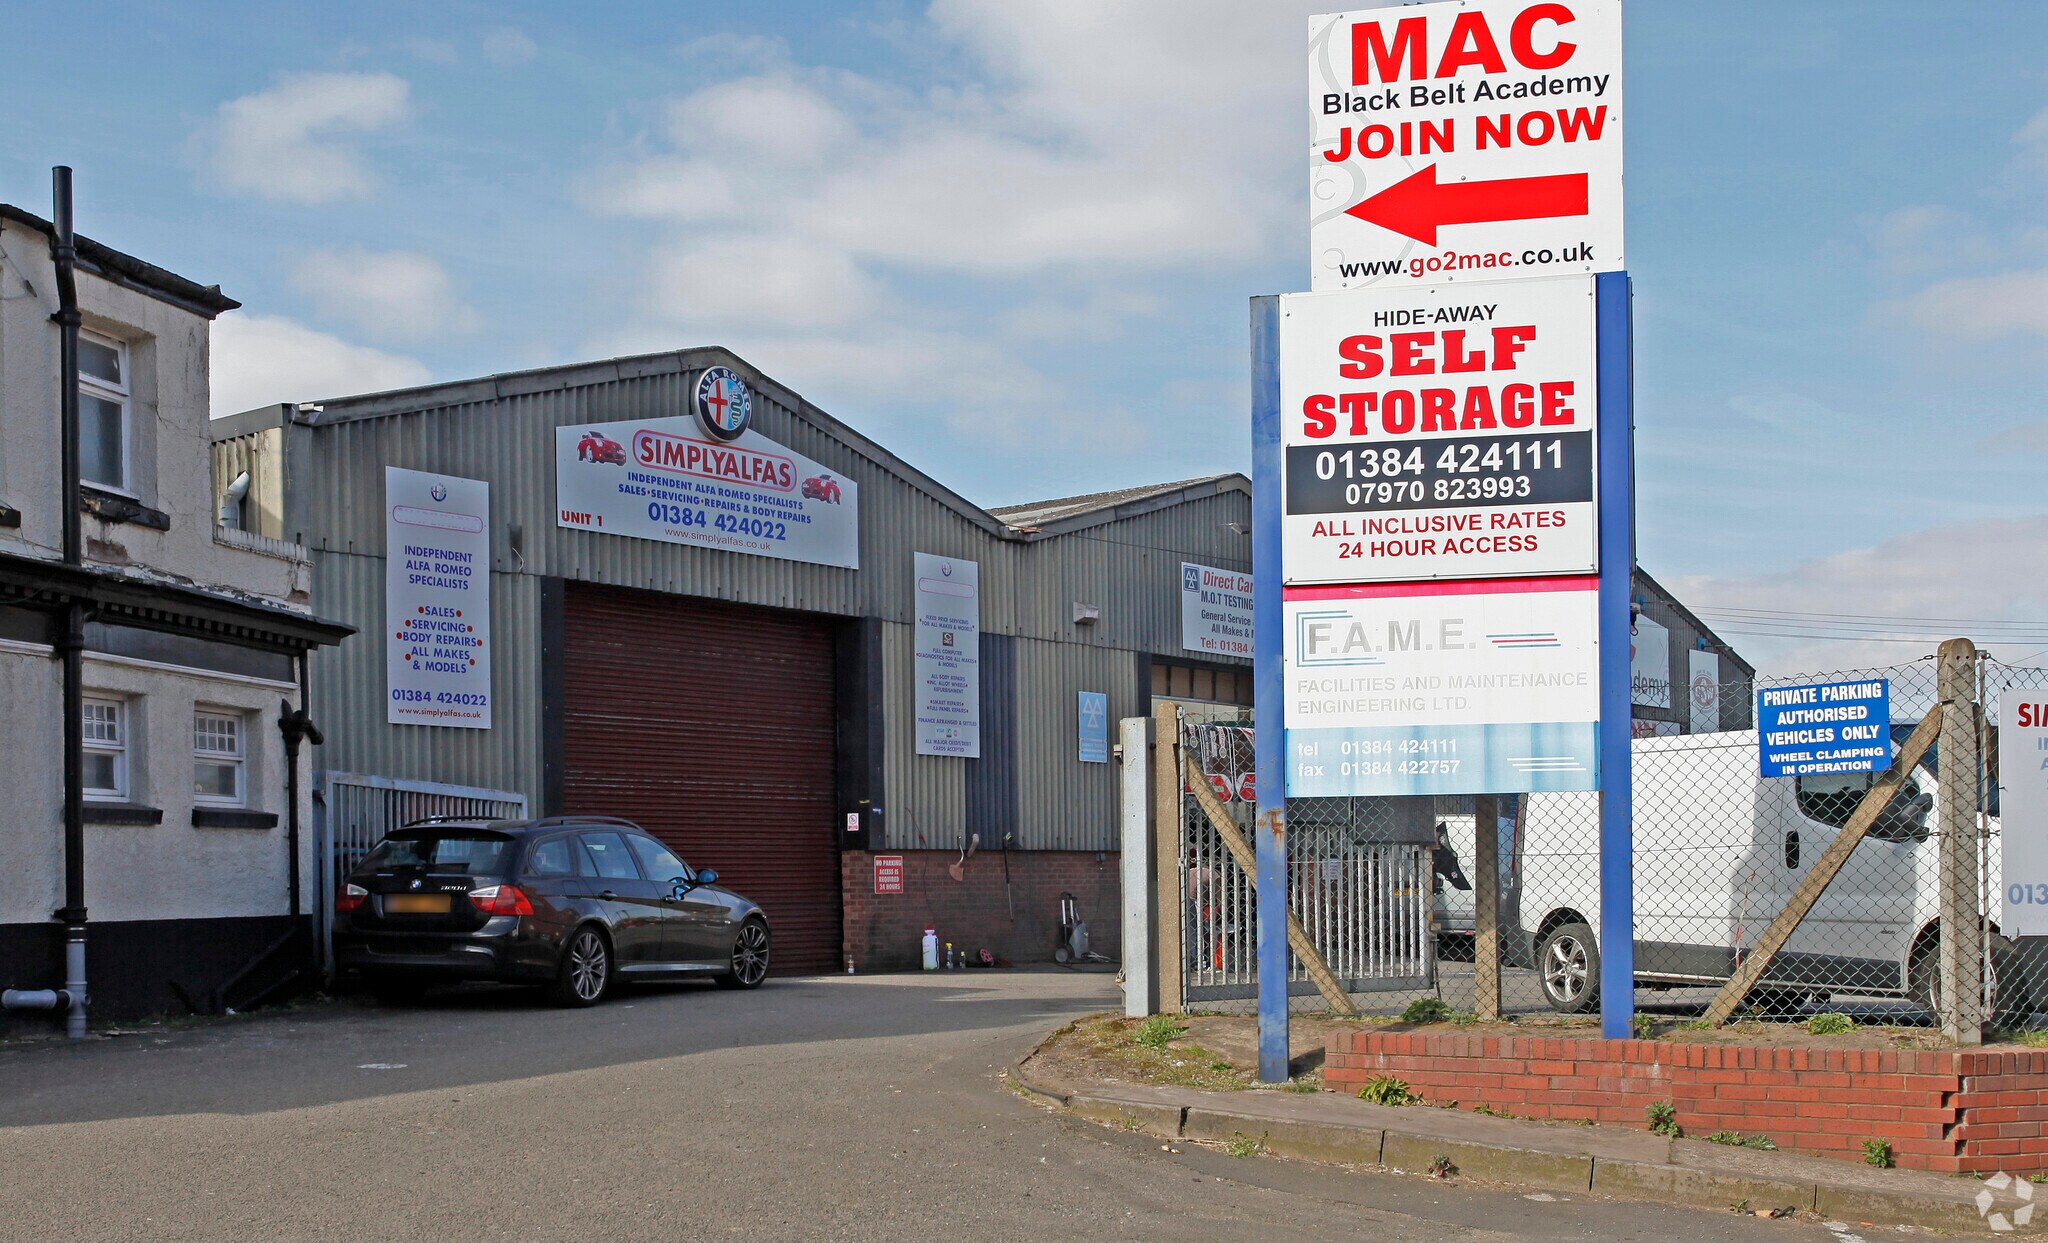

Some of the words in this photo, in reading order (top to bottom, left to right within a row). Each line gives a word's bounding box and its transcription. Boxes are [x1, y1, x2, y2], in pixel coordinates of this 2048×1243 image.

[1352, 3, 1577, 86] MAC
[1323, 89, 1400, 115] Black
[1410, 82, 1465, 107] Belt
[1473, 74, 1610, 102] Academy
[1323, 118, 1454, 163] JOIN
[1476, 105, 1608, 150] NOW
[1339, 242, 1594, 279] www.go2mac.co.uk
[1374, 304, 1498, 327] HIDE-AWAY
[1338, 325, 1536, 380] SELF
[700, 371, 719, 402] ALFA
[723, 369, 750, 411] ROMEO
[1302, 381, 1575, 439] STORAGE
[641, 436, 792, 487] SIMPLYALFAS
[1315, 446, 1425, 480] 01384
[1436, 439, 1562, 474] 424111
[627, 472, 693, 492] INDEPENDENT
[695, 483, 716, 496] ALFA
[718, 487, 751, 501] ROMEO
[753, 493, 804, 510] SPECIALISTS
[1345, 480, 1425, 505] 07970
[1433, 475, 1531, 501] 823993
[618, 484, 647, 497] SALES
[651, 489, 701, 504] SERVICING
[704, 498, 742, 513] REPAIRS
[743, 504, 750, 513] &
[752, 506, 776, 519] BODY
[777, 511, 812, 524] REPAIRS
[561, 511, 592, 526] UNIT
[597, 515, 603, 527] 1
[648, 502, 707, 528] 01384
[714, 514, 787, 541] 424022
[1311, 519, 1355, 538] ALL
[1361, 513, 1482, 535] INCLUSIVE
[1490, 510, 1566, 530] RATES
[665, 527, 771, 551] www.simplyalfas.co.uk
[1338, 542, 1363, 559] 24
[1370, 538, 1436, 558] HOUR
[1443, 534, 1538, 555] ACCESS
[404, 545, 473, 563] INDEPENDENT
[405, 559, 430, 572] ALFA
[435, 563, 472, 577] ROMEO
[409, 574, 469, 590] SPECIALISTS
[1203, 571, 1235, 590] Direct
[1201, 590, 1222, 606] M.O.T
[1224, 594, 1253, 611] TESTING
[424, 606, 455, 618] SALES
[1201, 609, 1227, 622] General
[1228, 613, 1251, 626] Service
[412, 619, 466, 634] SERVICING
[1211, 623, 1220, 633] All
[1222, 625, 1243, 637] Makes
[1244, 629, 1249, 638] &
[1309, 618, 1476, 655] F.A.M.E.
[403, 631, 432, 644] BODY
[436, 634, 477, 647] REPAIRS
[1200, 637, 1217, 649] Tel:
[1220, 640, 1248, 653] 01384
[411, 646, 429, 657] ALL
[433, 648, 470, 660] MAKES
[412, 660, 421, 670] &
[425, 661, 467, 674] MODELS
[1297, 676, 1396, 694] FACILITIES
[1402, 675, 1442, 691] AND
[1448, 672, 1588, 690] MAINTENANCE
[1633, 670, 1666, 702] demy
[392, 689, 432, 703] 01384
[436, 692, 487, 706] 424022
[1764, 688, 1817, 706] PRIVATE
[1821, 682, 1882, 702] PARKING
[398, 707, 482, 719] www.simplyalfas.co.uk
[1297, 697, 1426, 715] ENGINEERING
[1433, 696, 1472, 711] LTD.
[1777, 705, 1867, 725] AUTHORISED
[1766, 728, 1834, 746] VEHICLES
[1842, 725, 1880, 740] ONLY
[1297, 741, 1319, 756] tel
[1341, 740, 1392, 756] 01384
[1398, 739, 1457, 754] 424111
[1769, 751, 1813, 763] WHEEL
[1816, 747, 1884, 760] CLAMPING
[1297, 762, 1324, 777] fax
[1340, 761, 1392, 776] 01384
[1398, 759, 1460, 775] 422757
[1782, 765, 1796, 774] IN
[1798, 760, 1872, 774] OPERATION
[2008, 883, 2048, 905] 013
